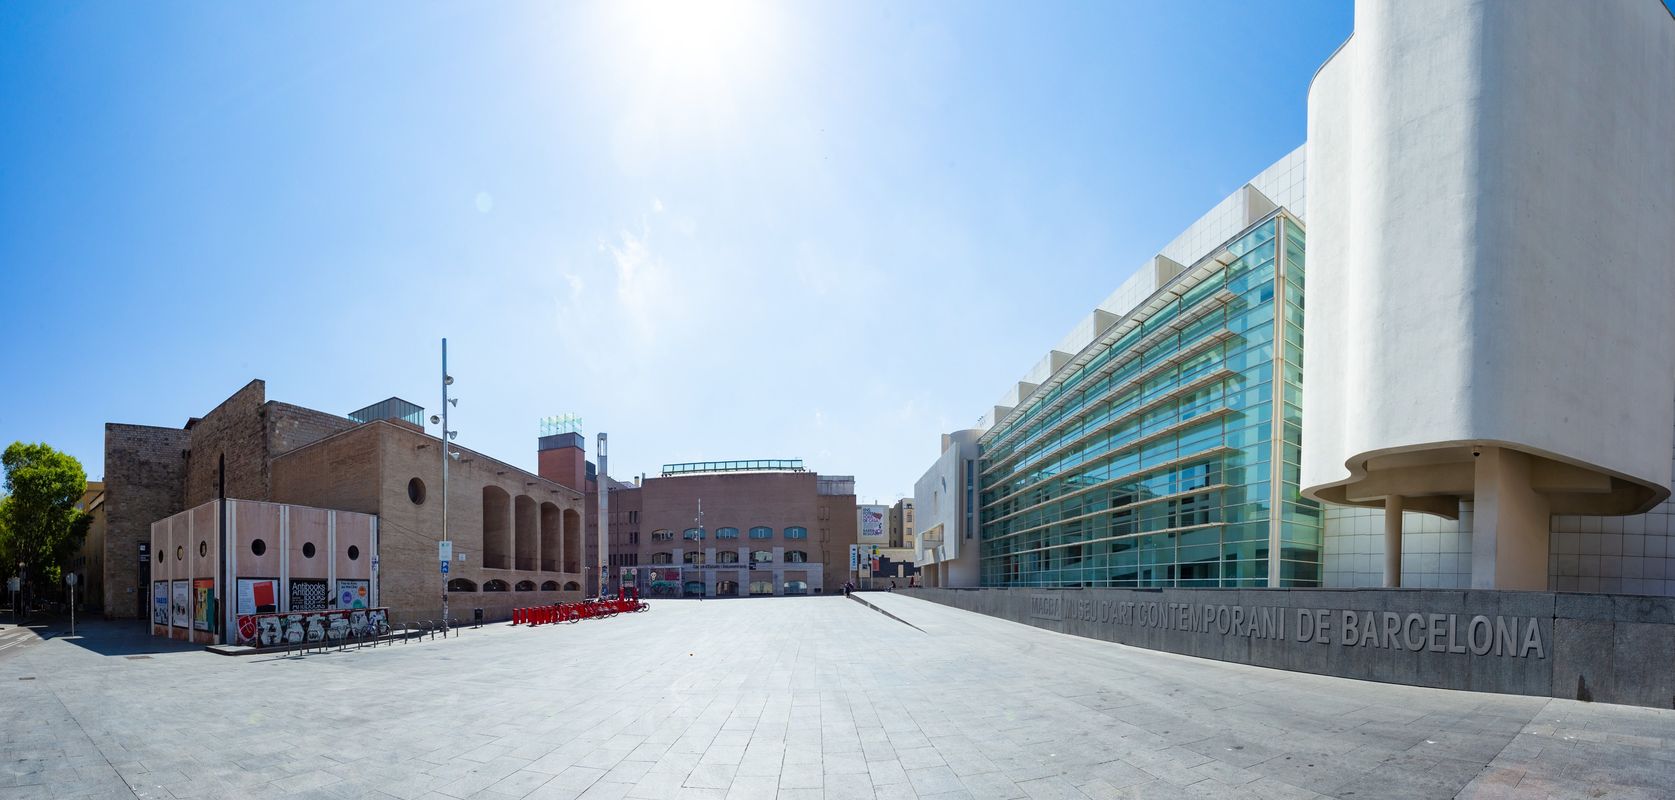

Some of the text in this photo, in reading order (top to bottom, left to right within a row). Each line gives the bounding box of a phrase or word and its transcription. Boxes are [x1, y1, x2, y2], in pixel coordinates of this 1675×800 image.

[292, 582, 326, 590] Antibooks
[1065, 599, 1098, 622] MUSEU
[1101, 600, 1136, 627] D'ART
[1138, 601, 1285, 640] CONTEMPORANI
[1297, 608, 1331, 645] DE
[1341, 610, 1546, 659] BARCELONA
